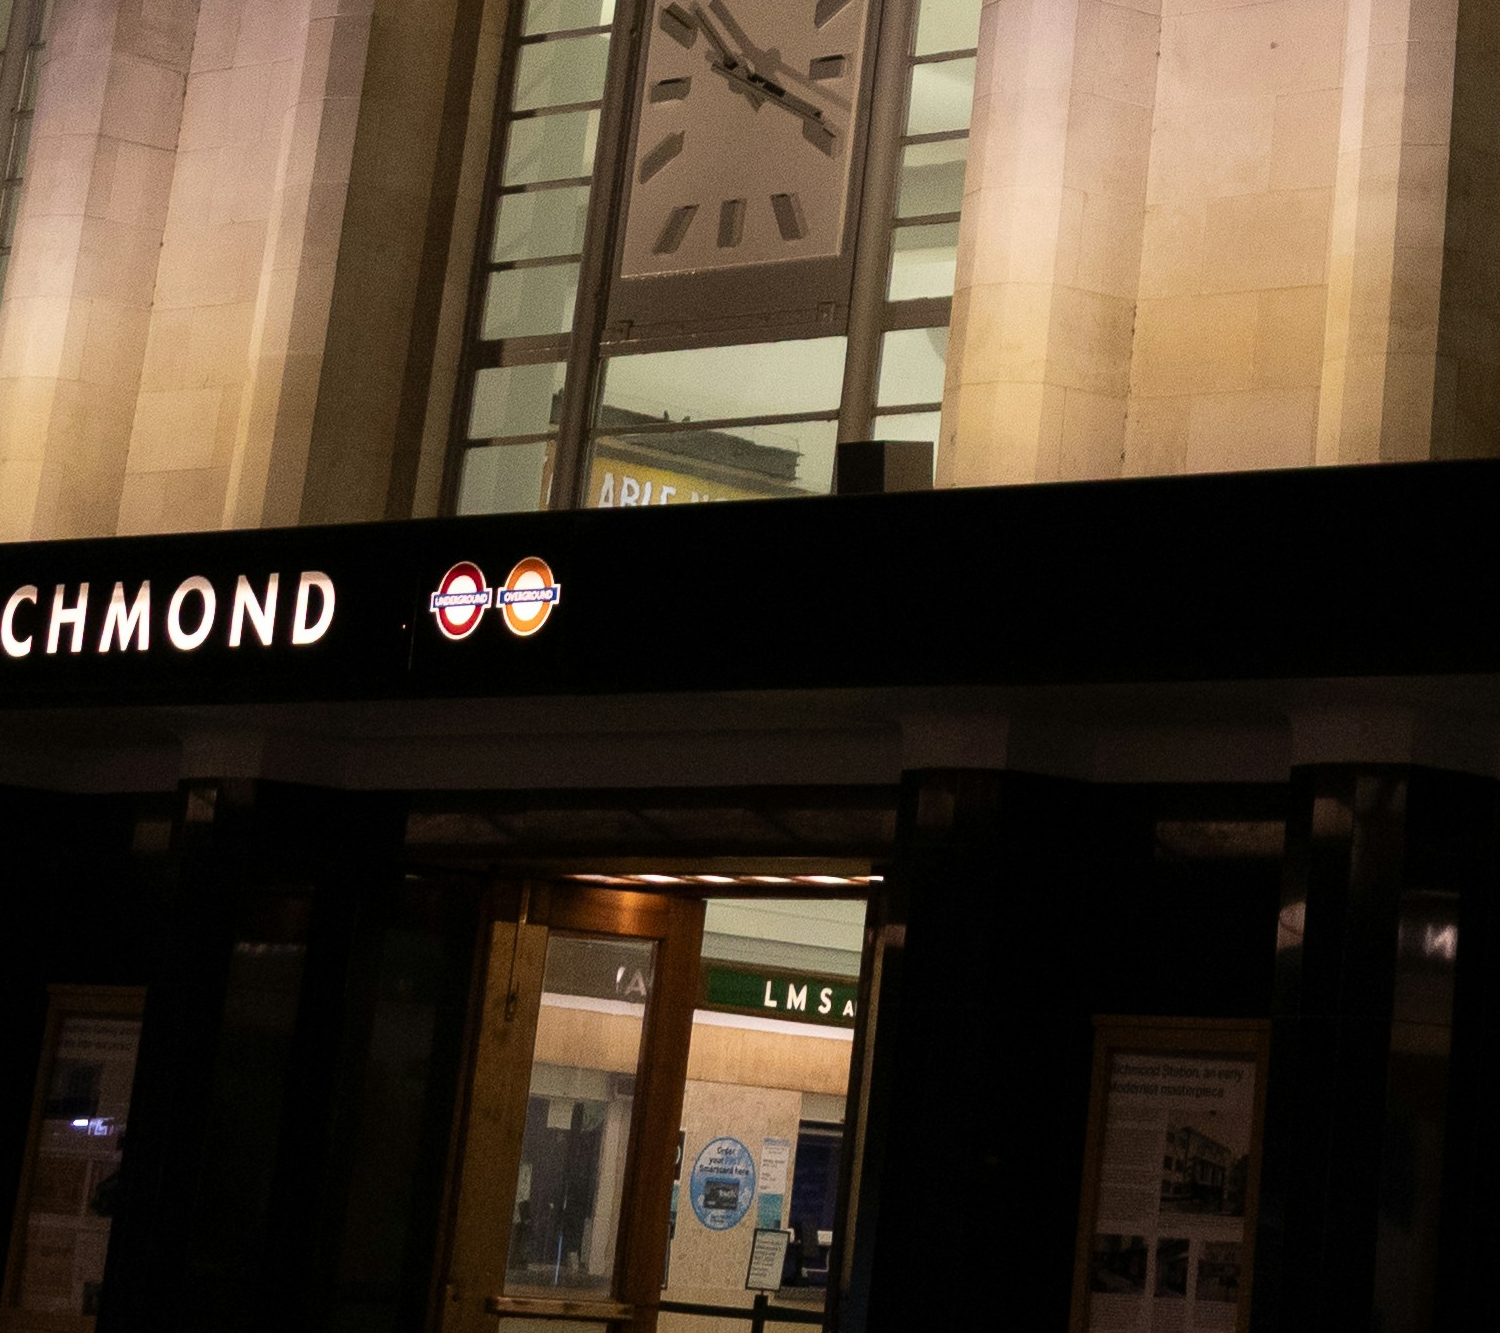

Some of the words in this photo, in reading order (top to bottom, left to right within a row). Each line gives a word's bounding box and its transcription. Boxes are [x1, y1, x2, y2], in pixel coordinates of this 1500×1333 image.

[435, 592, 488, 606] UNDERGROUND
[504, 589, 554, 603] OVERGROUND
[842, 1000, 858, 1018] A
[1112, 1064, 1160, 1076] ichmond
